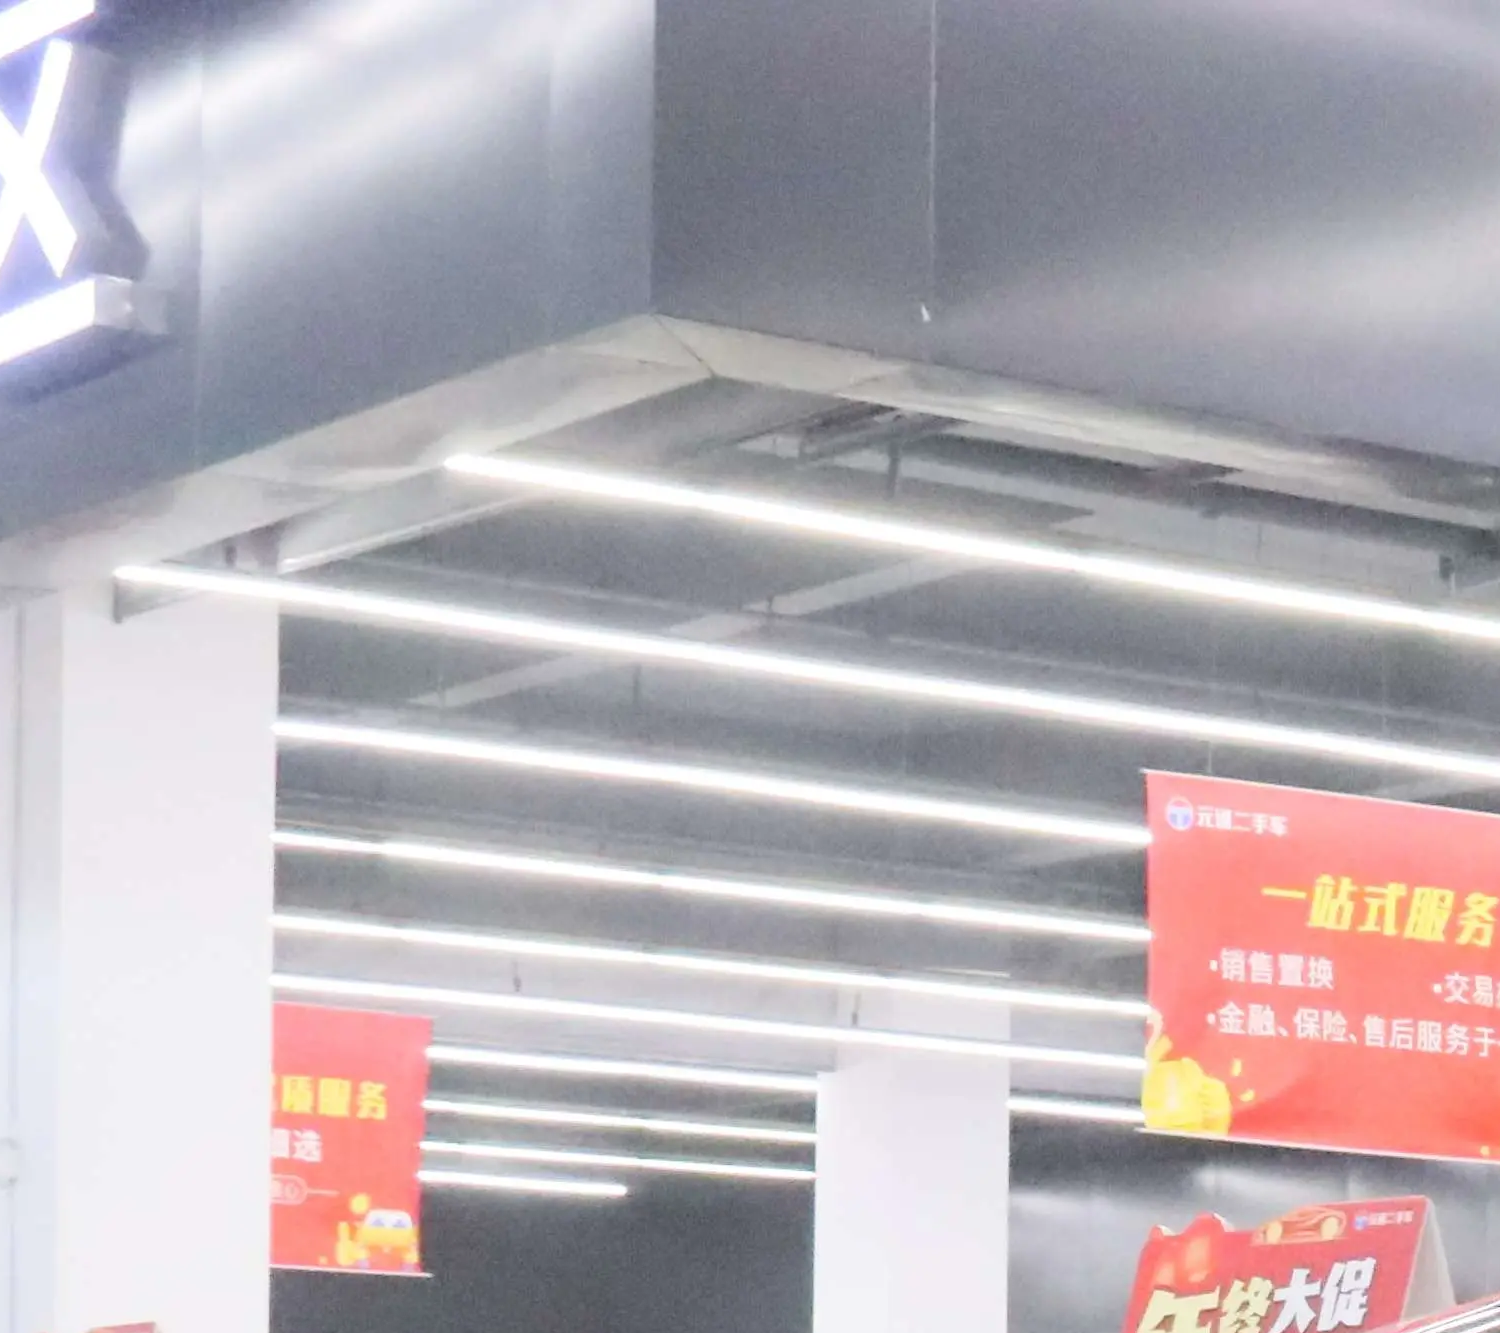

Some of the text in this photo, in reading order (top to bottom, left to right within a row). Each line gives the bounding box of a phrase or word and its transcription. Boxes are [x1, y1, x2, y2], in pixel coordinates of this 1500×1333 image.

[1261, 874, 1499, 947] 一站式服务
[1219, 948, 1335, 990] 销售置换
[270, 1075, 387, 1120] 质服务
